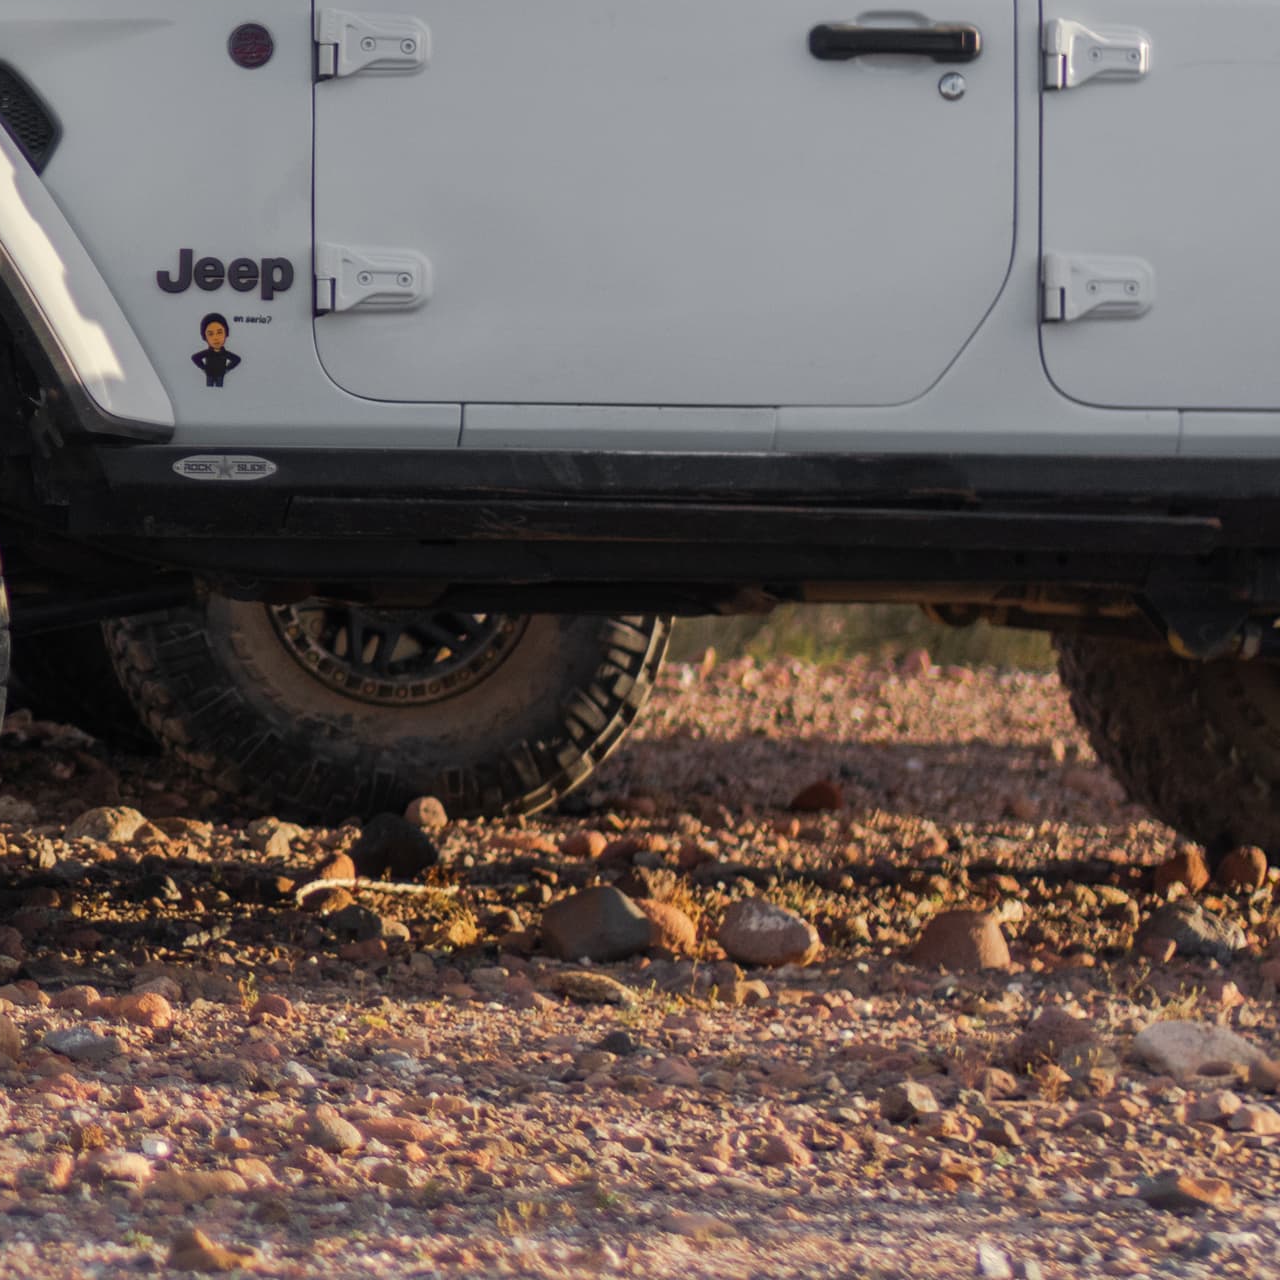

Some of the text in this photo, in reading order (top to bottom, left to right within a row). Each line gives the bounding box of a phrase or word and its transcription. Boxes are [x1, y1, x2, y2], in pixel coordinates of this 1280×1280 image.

[156, 248, 295, 301] Jeep
[183, 463, 267, 473] ROCK SLIDE
